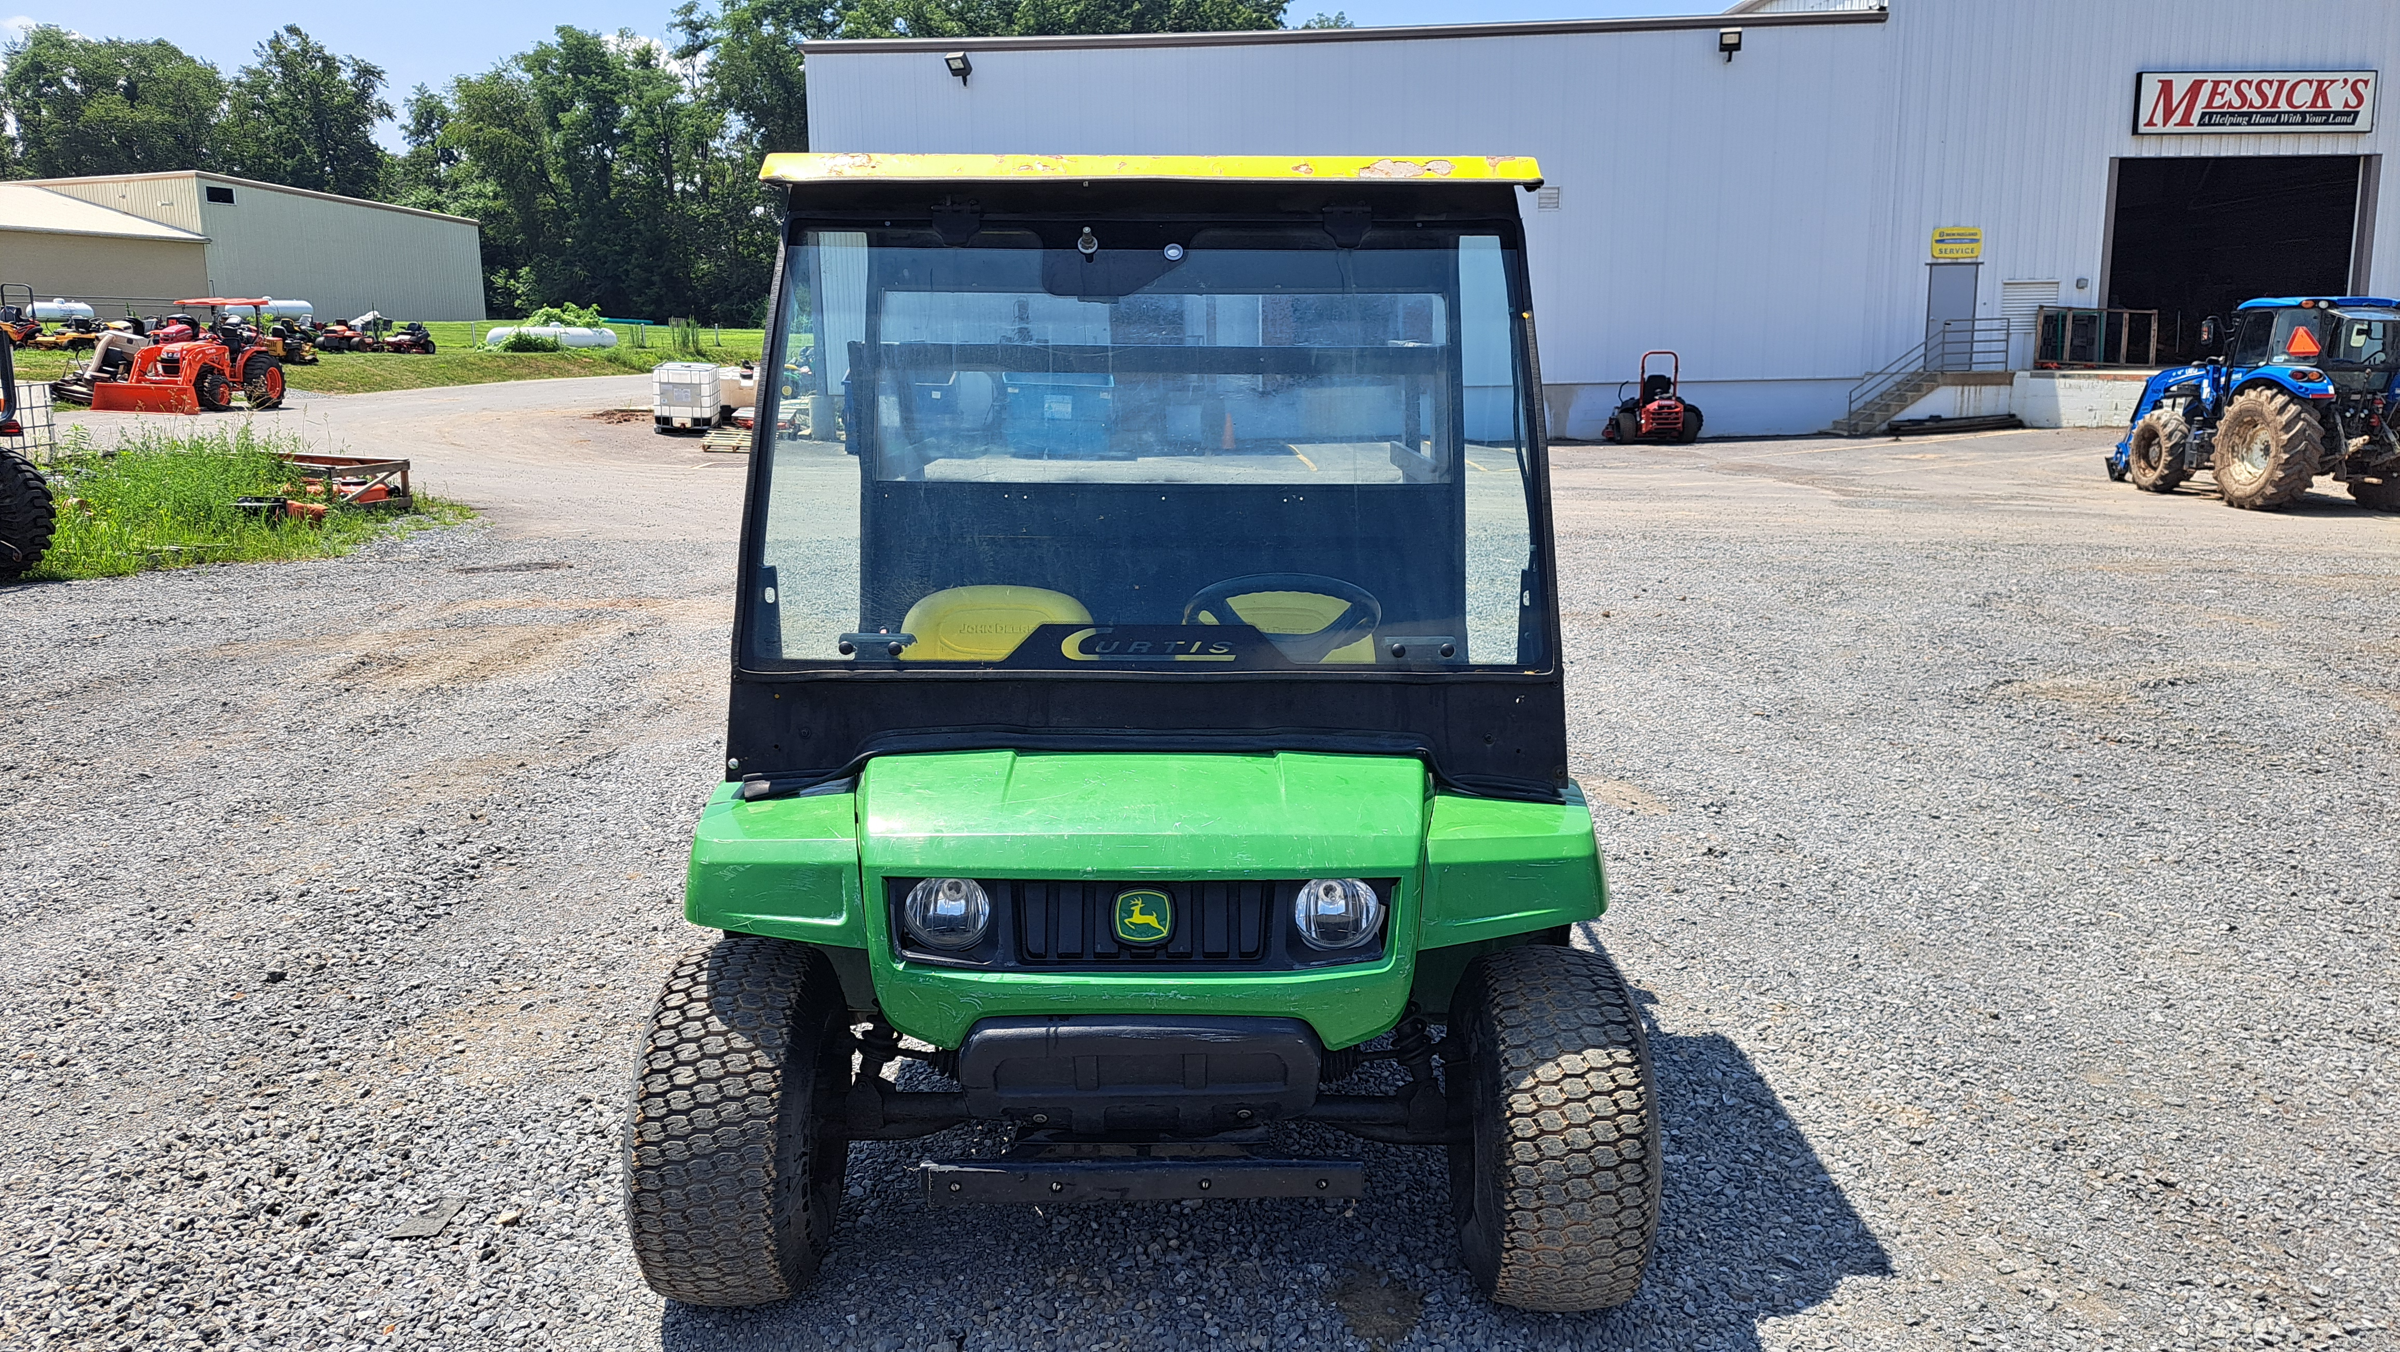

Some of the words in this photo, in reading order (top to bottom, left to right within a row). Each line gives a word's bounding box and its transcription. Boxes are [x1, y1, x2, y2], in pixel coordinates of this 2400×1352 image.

[2143, 78, 2370, 128] MESSICK'S
[2200, 114, 2209, 124] A
[2210, 114, 2249, 126] Helping
[2250, 113, 2279, 124] Hand
[2280, 113, 2302, 124] With
[2305, 113, 2327, 124] Your
[2328, 113, 2355, 123] Land
[1938, 247, 1976, 255] SERVICE
[959, 623, 993, 634] JOHN
[1061, 627, 1236, 661] CURTIS
